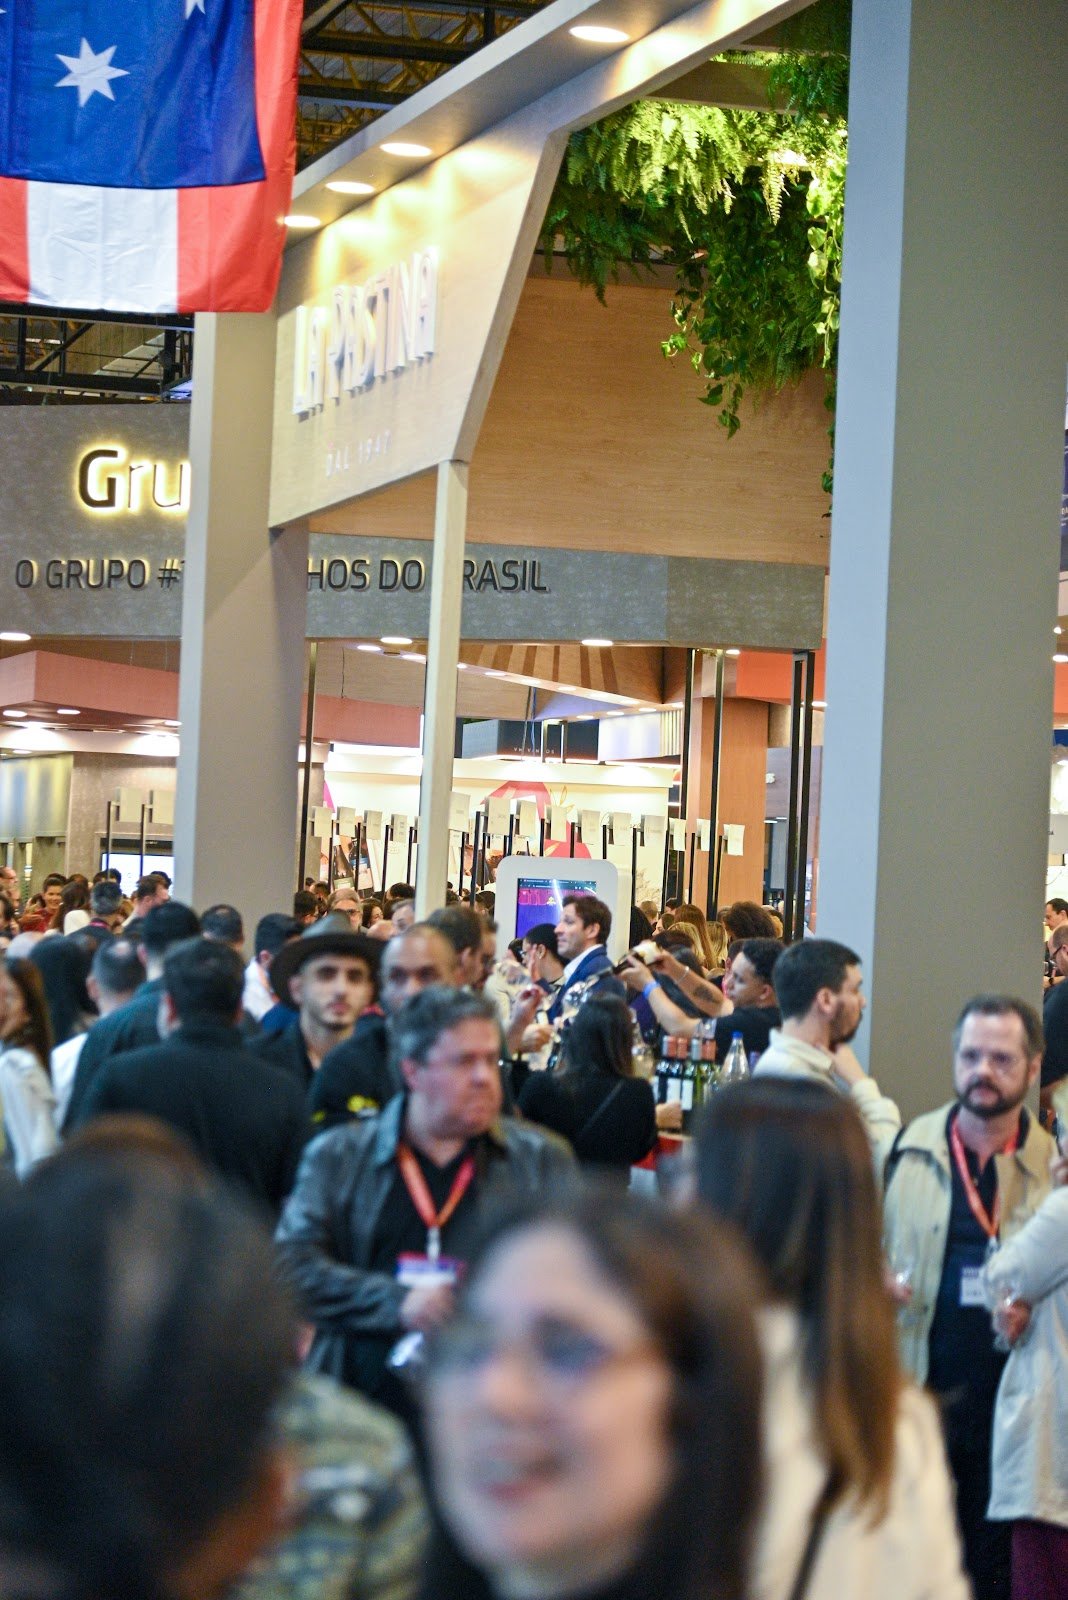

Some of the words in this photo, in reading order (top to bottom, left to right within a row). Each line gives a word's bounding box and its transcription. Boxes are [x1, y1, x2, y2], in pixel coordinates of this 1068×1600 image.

[293, 305, 327, 414] LA
[328, 246, 437, 398] PASTINA
[79, 449, 188, 508] Gru
[15, 559, 35, 589] O
[46, 559, 147, 589] GRUPO
[307, 559, 370, 591] HOS
[379, 559, 425, 590] DO
[463, 559, 548, 592] RASIL
